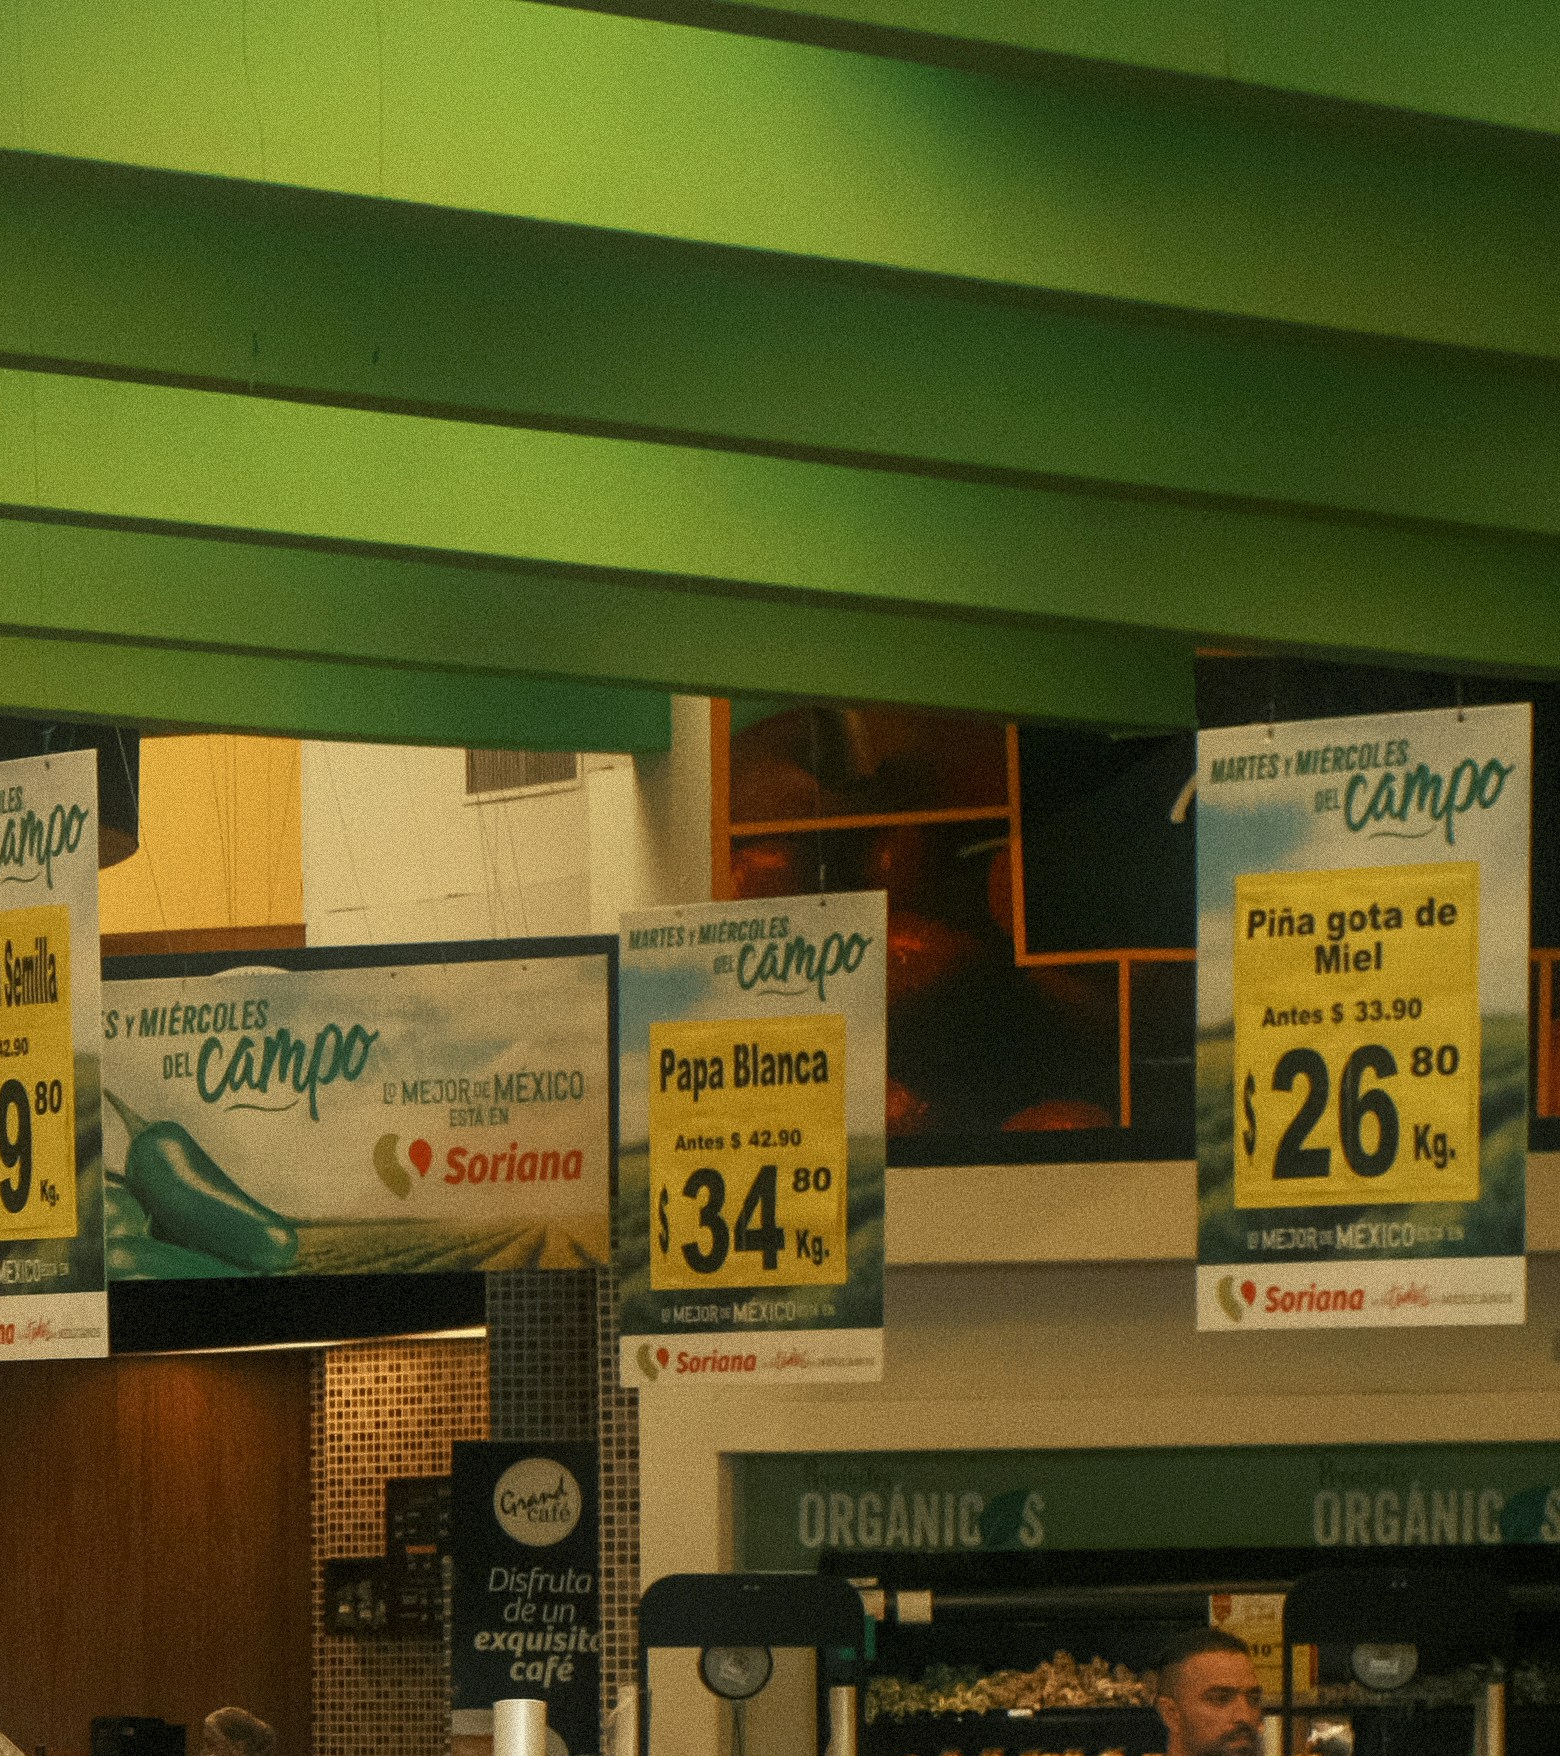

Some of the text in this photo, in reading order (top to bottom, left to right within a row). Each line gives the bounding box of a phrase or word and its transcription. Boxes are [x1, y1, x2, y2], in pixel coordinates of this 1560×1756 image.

[1210, 739, 1411, 784] MARTES MIÉRCOLES
[1314, 758, 1515, 846] DEL campo
[628, 916, 790, 951] MARTES MIÉRCOLES
[1246, 896, 1457, 942] Piña gota de
[4, 937, 59, 1008] Semilla
[712, 932, 874, 1002] DEL campo
[1314, 941, 1383, 976] Miel
[138, 1000, 269, 1039] MIÉRCOLES
[1262, 997, 1423, 1028] Antes $ 33.90
[163, 1023, 380, 1122] DEL campo
[401, 1079, 469, 1106] MEJOR
[494, 1066, 584, 1103] MÉXICO
[659, 1043, 829, 1103] Papa Blanca
[34, 1079, 63, 1116] 80
[449, 1103, 509, 1128] ESTÁ EN
[1243, 1044, 1460, 1181] $ 26 80
[675, 1128, 802, 1152] Antes $ 42.90
[1413, 1123, 1456, 1170] Kg.
[443, 1142, 584, 1185] Soriana
[39, 1179, 60, 1207] Kg.
[658, 1164, 832, 1275] $ 34 80
[1261, 1222, 1414, 1250] MEJOR MÉXICO
[795, 1229, 831, 1267] Kg.
[672, 1305, 718, 1323] MEJOR
[732, 1302, 795, 1323] MÉXICO
[1264, 1282, 1365, 1314] Soriana
[675, 1350, 757, 1375] Soriana
[500, 1474, 568, 1518] Grand
[527, 1504, 571, 1523] café
[488, 1566, 592, 1600] Disfruta
[503, 1597, 576, 1623] de un
[509, 1654, 574, 1689] café
